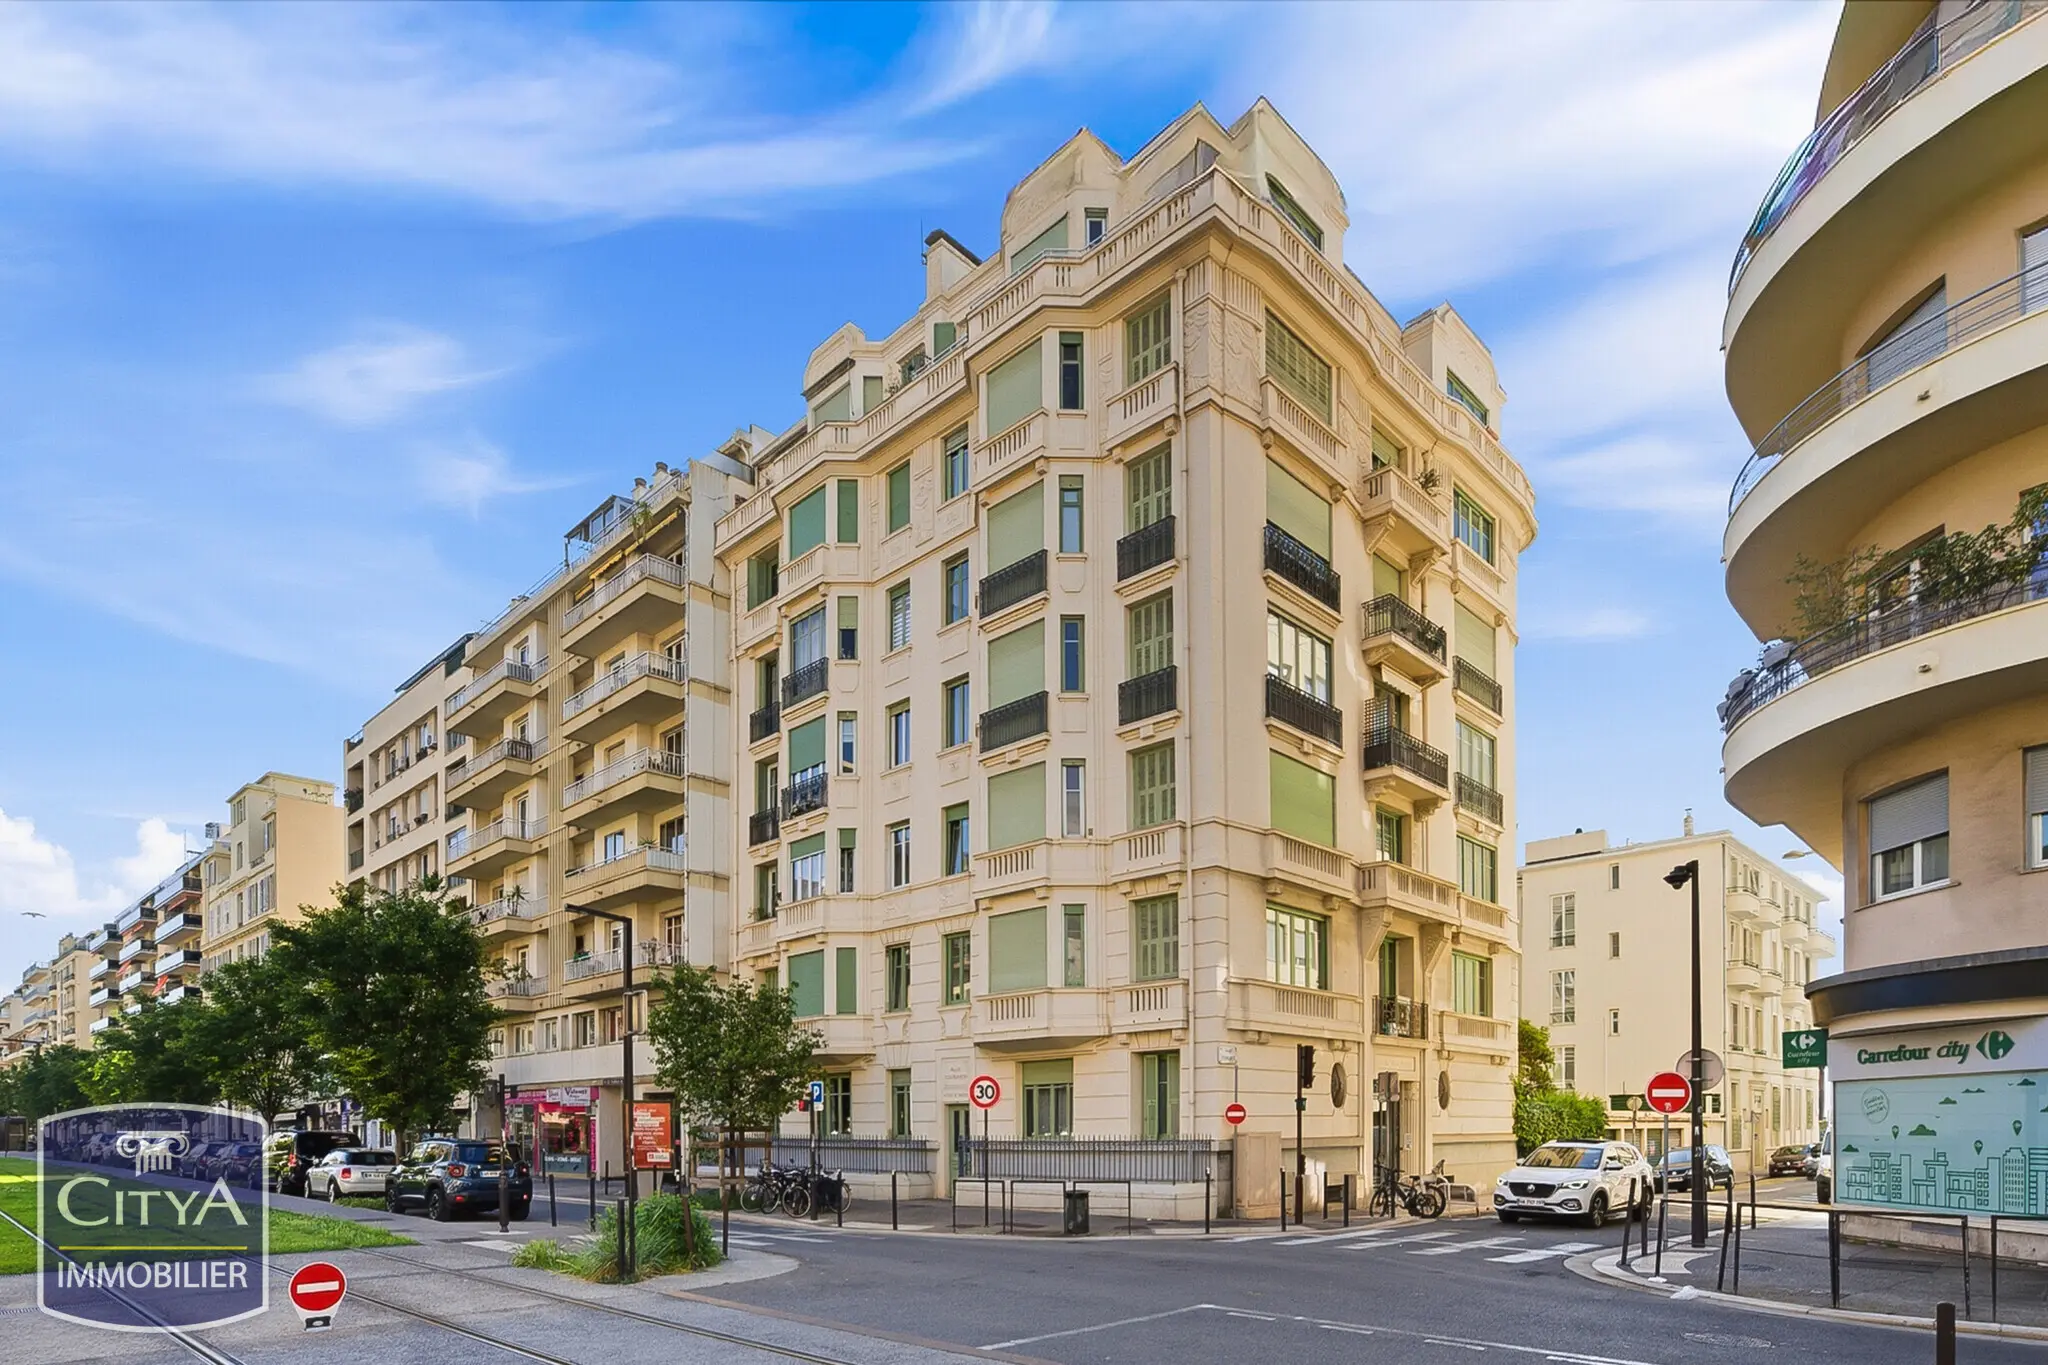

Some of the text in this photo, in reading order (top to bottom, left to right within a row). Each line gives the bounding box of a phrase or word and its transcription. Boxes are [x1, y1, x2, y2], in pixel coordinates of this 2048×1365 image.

[1857, 1041, 1970, 1064] Carrefour city
[813, 1085, 820, 1100] P
[976, 1085, 995, 1099] 30
